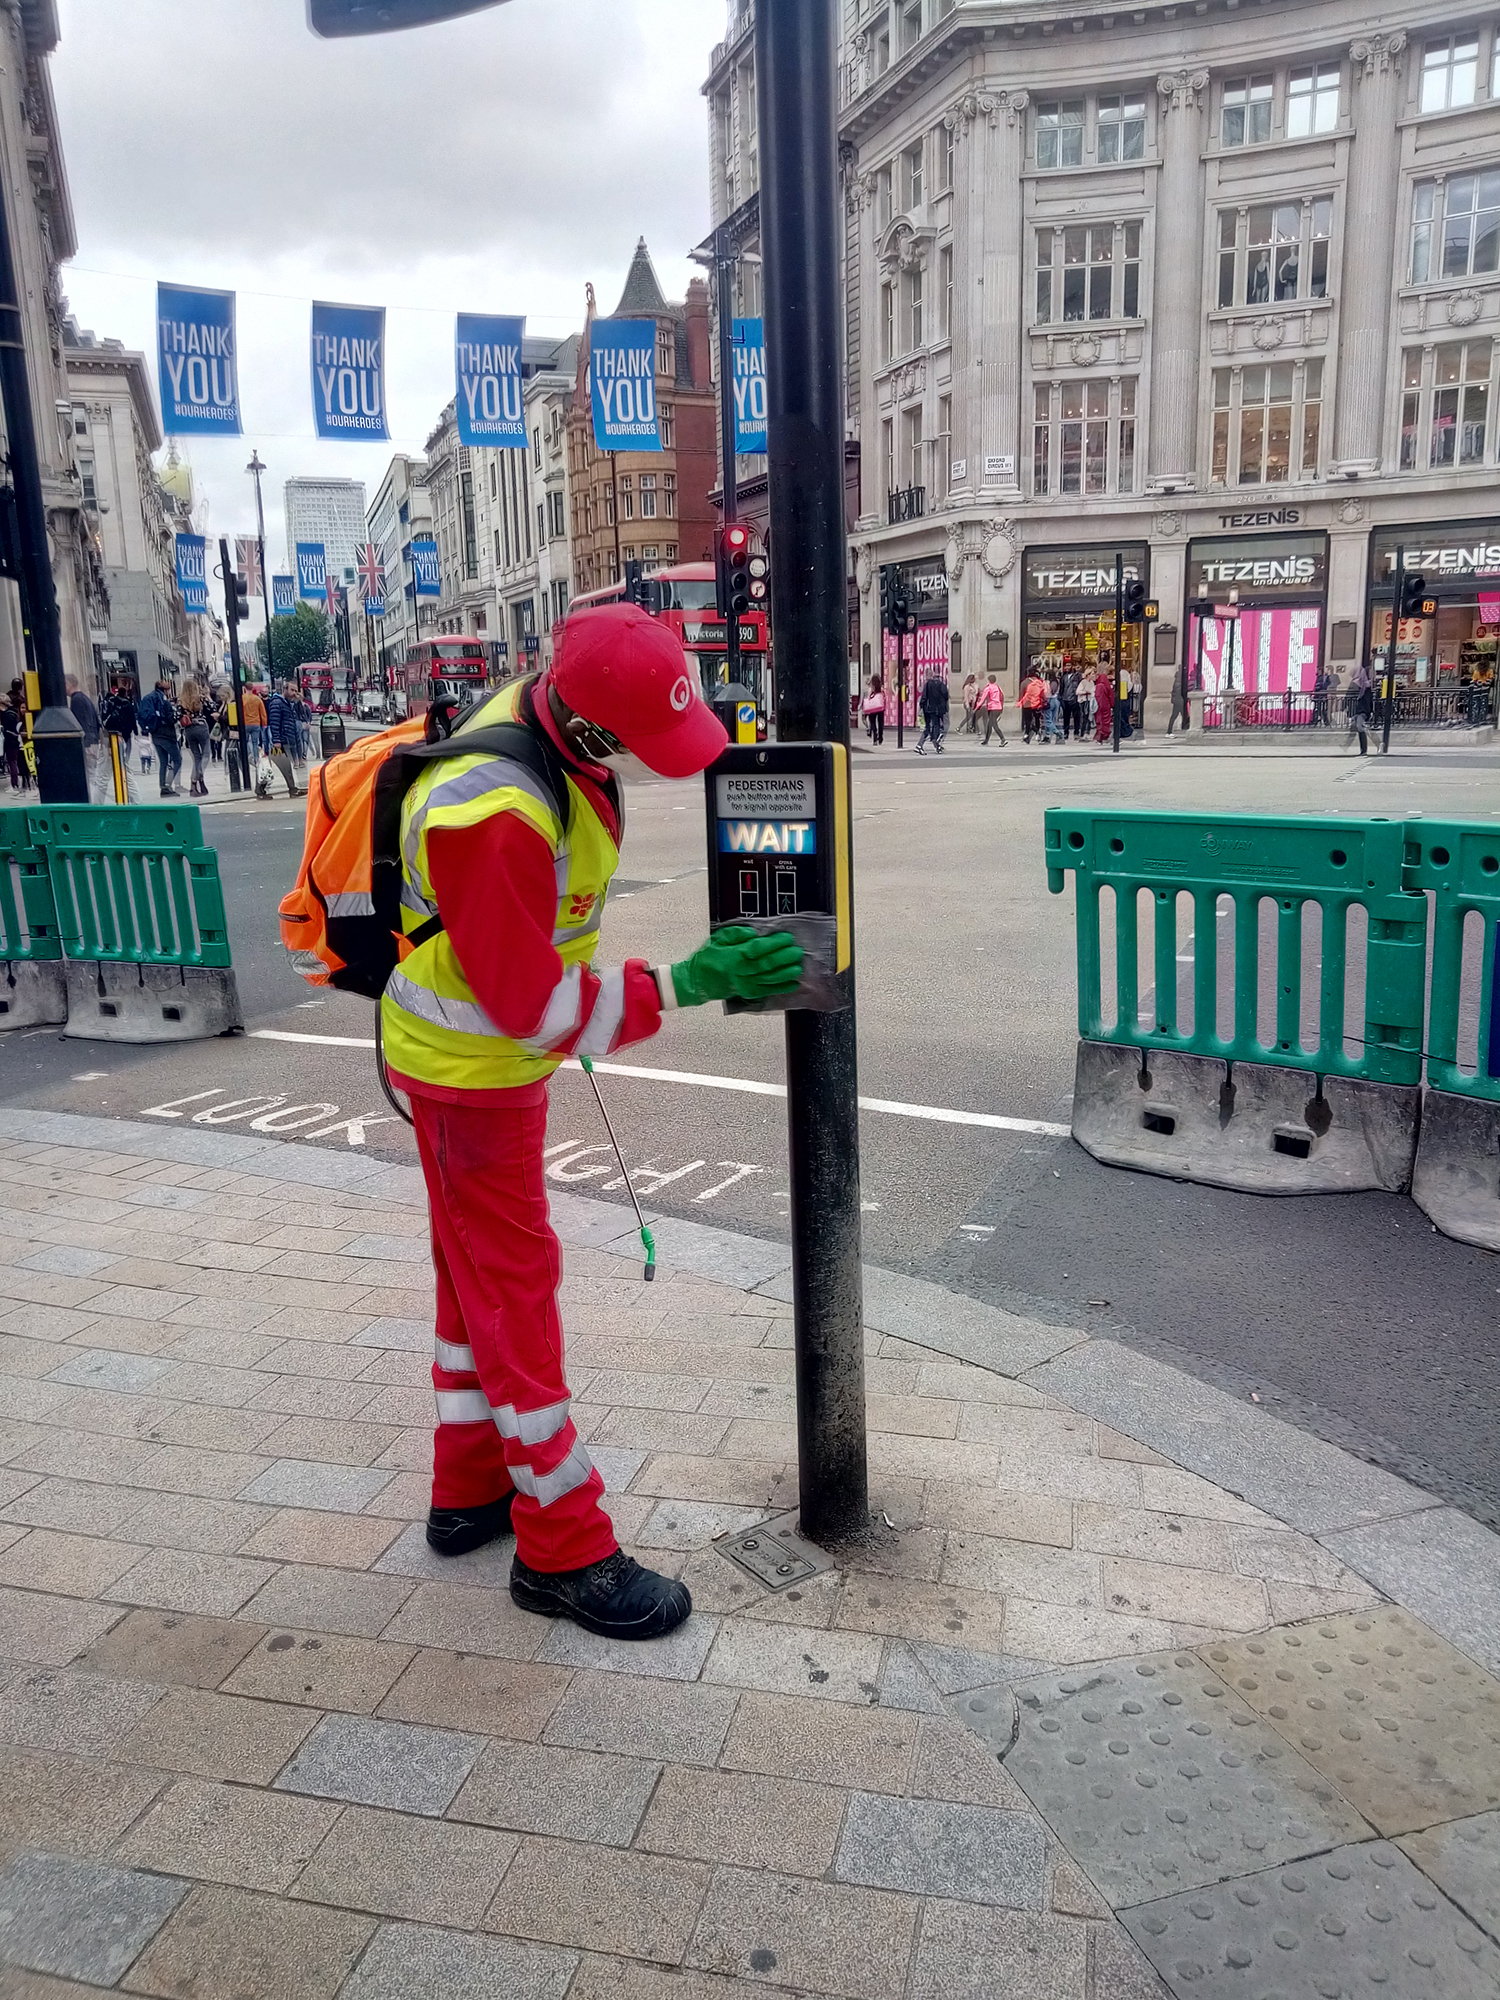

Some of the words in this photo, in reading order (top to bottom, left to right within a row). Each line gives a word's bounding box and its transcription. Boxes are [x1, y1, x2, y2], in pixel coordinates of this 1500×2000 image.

[160, 319, 232, 357] THANK
[313, 335, 380, 369] THANK
[457, 343, 519, 374] THANK
[593, 348, 652, 377] THANK
[165, 354, 232, 407] YOU
[317, 367, 380, 416] YOU
[461, 375, 521, 421] YOU
[597, 379, 654, 422] YOU
[733, 377, 768, 419] YO
[175, 403, 235, 421] #OURHEROES
[326, 414, 382, 429] #OURHEROES
[470, 422, 523, 434] #OURHEROES
[605, 423, 656, 435] #OURHEROES
[1219, 508, 1299, 528] TEZENIS
[177, 545, 204, 558] THANK
[298, 554, 324, 566] THANK
[415, 552, 438, 562] THANK
[179, 558, 204, 576] YOU
[300, 566, 326, 584] YOU
[417, 562, 439, 580] YOU
[1202, 556, 1315, 581] TEZENIS
[1033, 566, 1138, 589] TEZENS
[1253, 576, 1314, 586] underwear
[274, 583, 293, 592] THANK
[275, 592, 294, 606] YOU
[1422, 601, 1435, 613] 03
[728, 780, 804, 790] PEDESTRIANS
[727, 793, 746, 802] push
[747, 793, 772, 801] button
[774, 793, 789, 801] and
[790, 793, 807, 801] wait
[731, 803, 743, 811] for
[744, 803, 767, 812] signal
[769, 803, 803, 812] opposite
[727, 823, 809, 852] WAIT
[139, 1088, 402, 1145] LOOK
